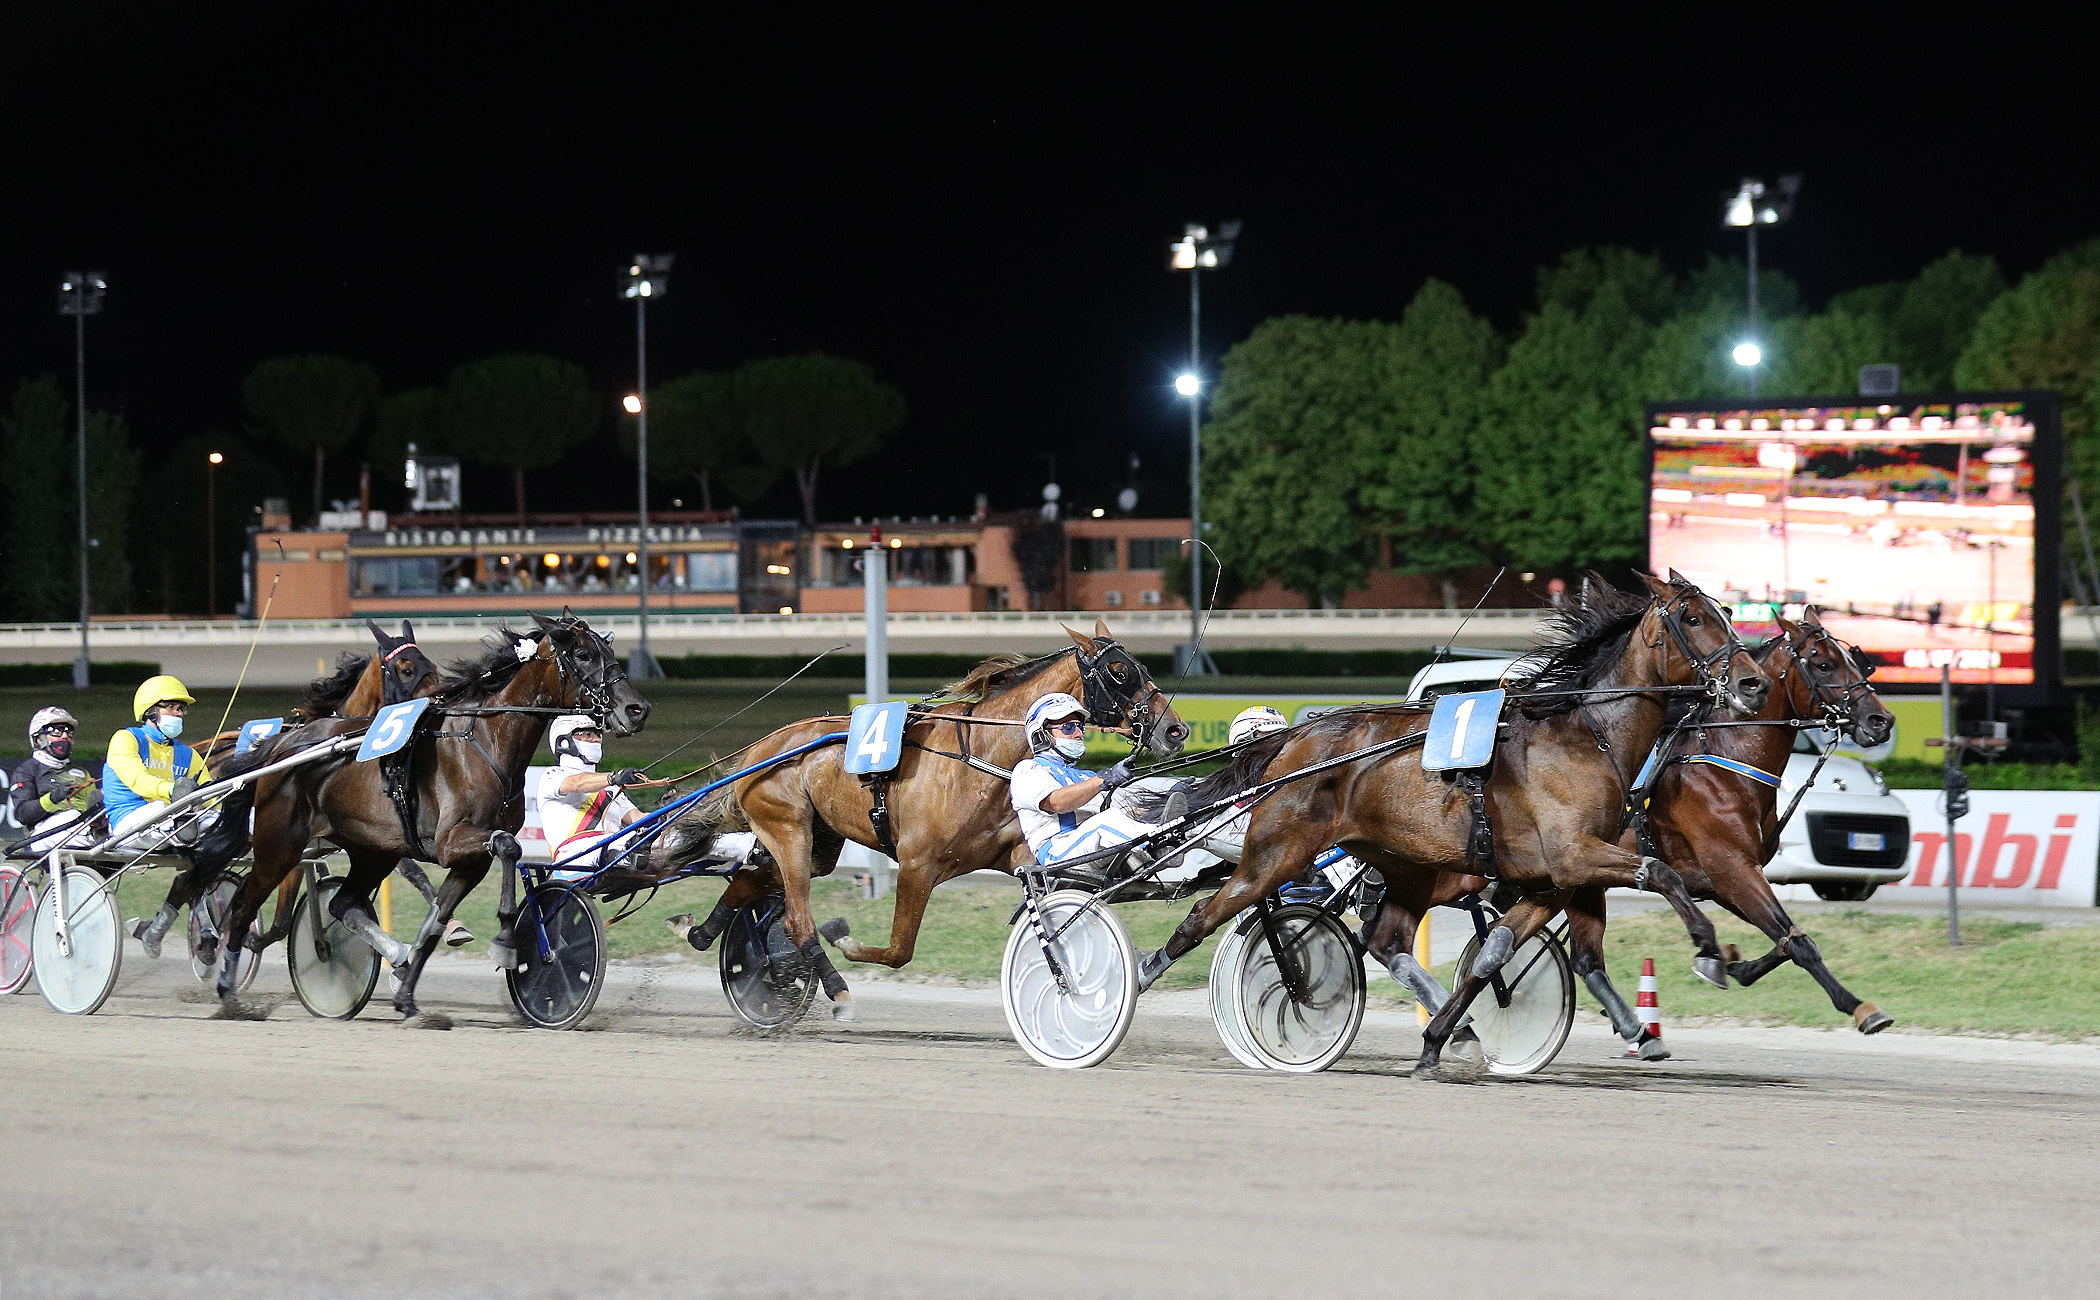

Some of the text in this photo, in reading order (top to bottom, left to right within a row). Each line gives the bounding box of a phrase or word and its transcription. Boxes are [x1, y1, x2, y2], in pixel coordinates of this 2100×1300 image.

[385, 527, 702, 546] RISTORANTE PIZZERIA
[371, 704, 415, 751] 5
[857, 709, 889, 764] 4
[1450, 698, 1477, 760] 1
[1147, 815, 1186, 838] COBRA
